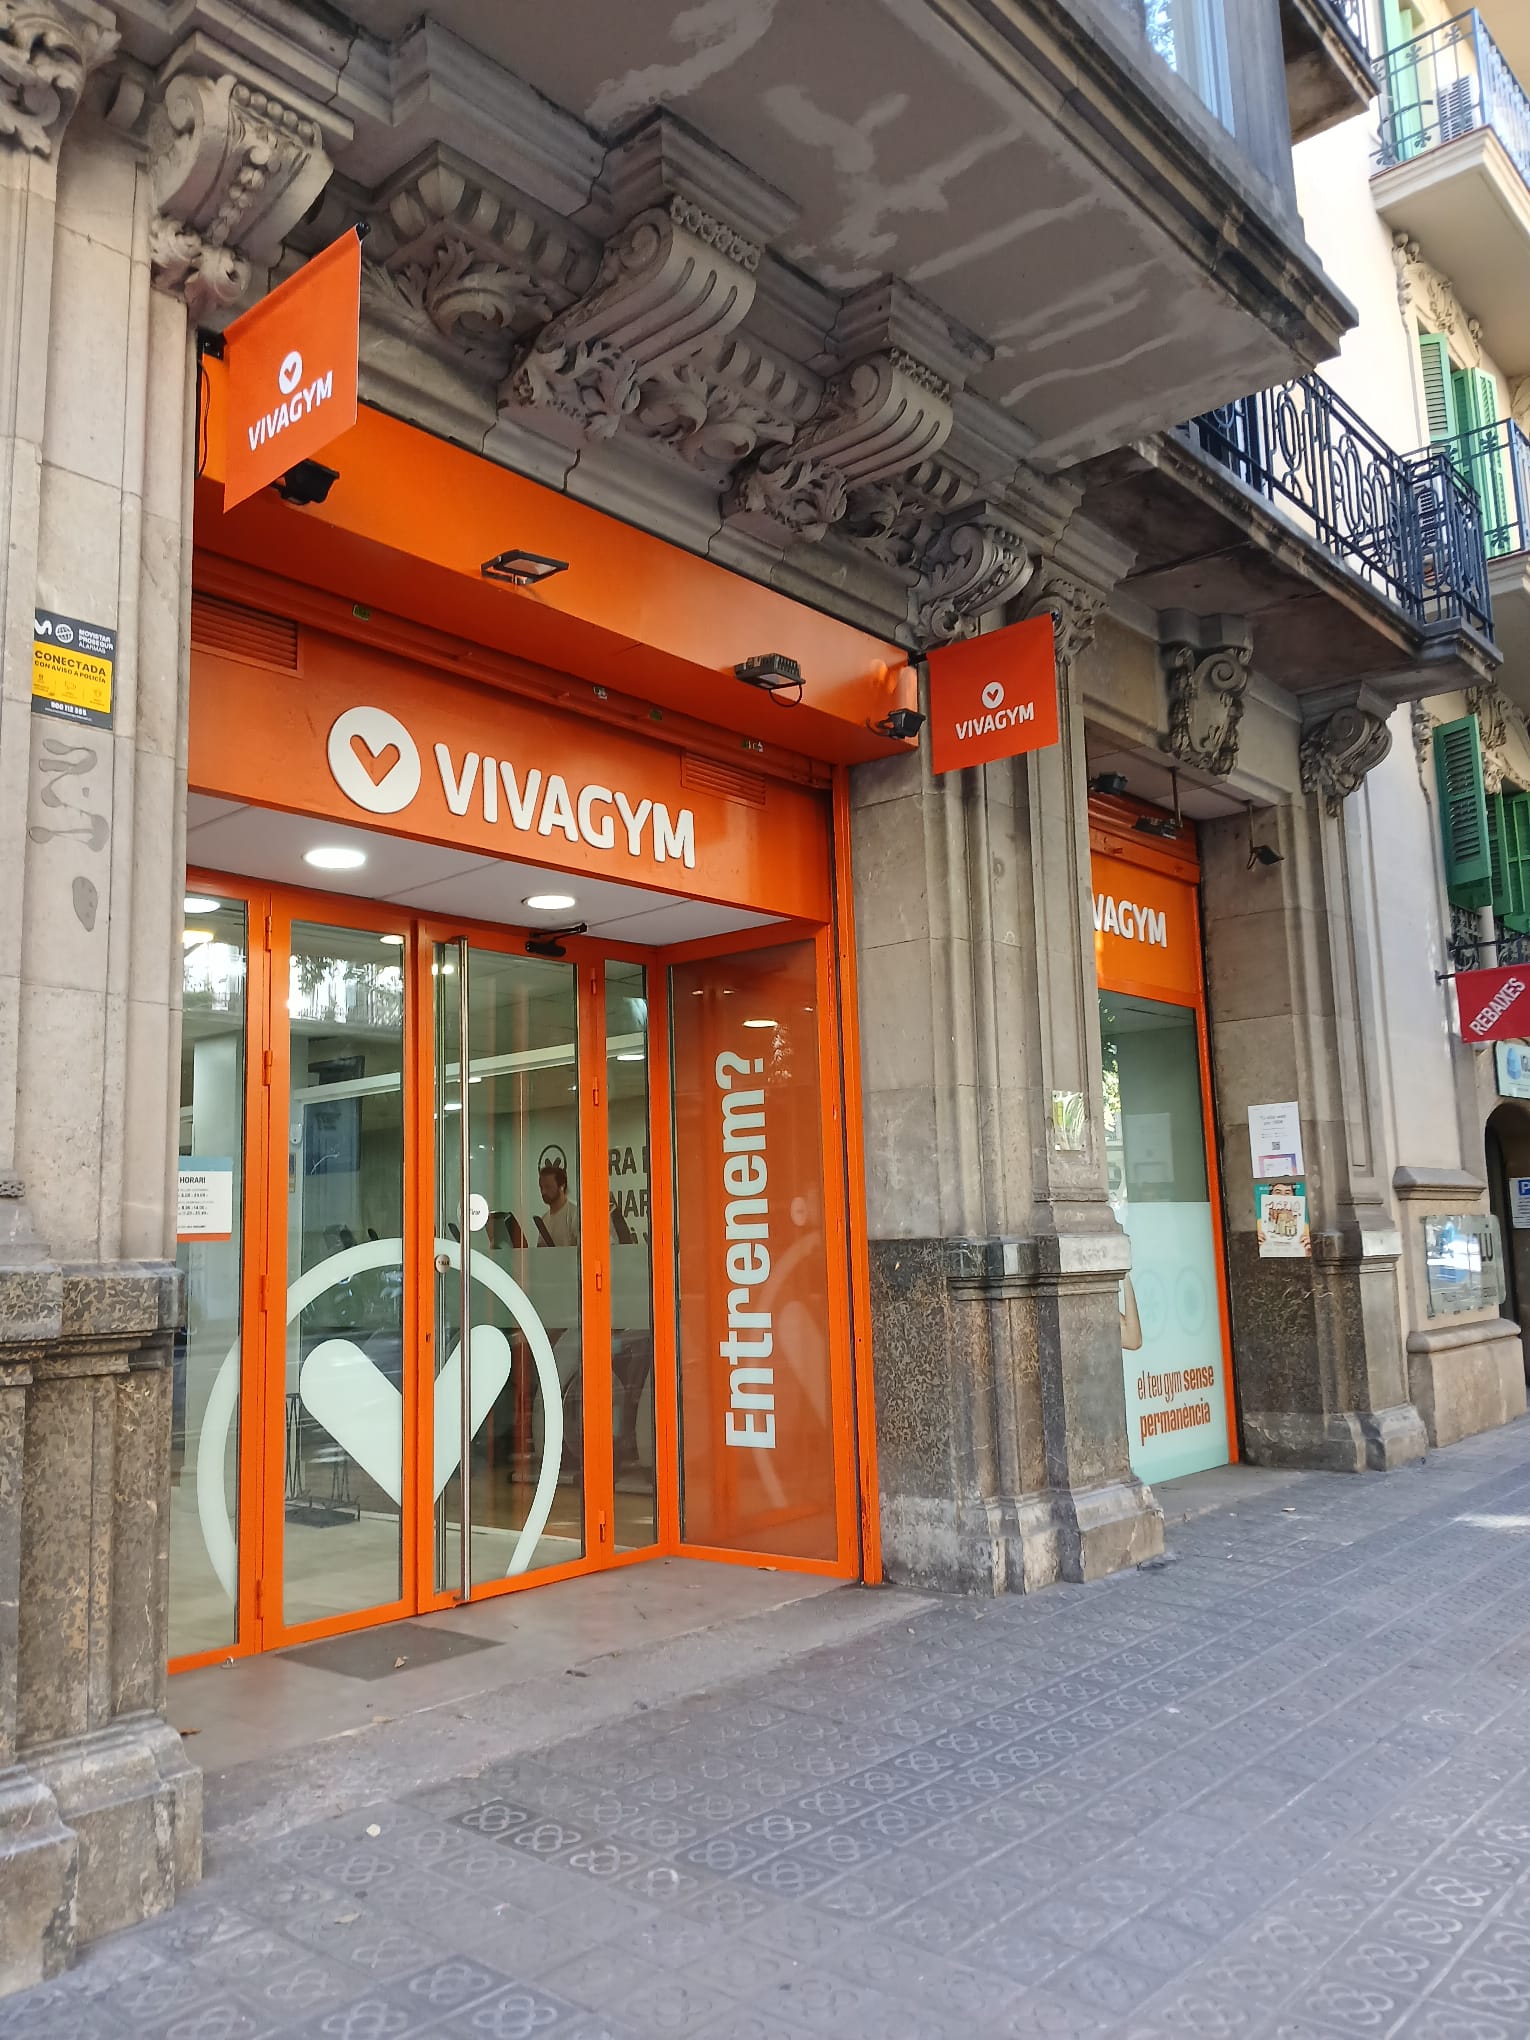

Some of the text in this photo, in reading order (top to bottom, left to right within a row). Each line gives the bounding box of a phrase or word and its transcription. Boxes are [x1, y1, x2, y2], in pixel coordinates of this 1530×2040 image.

[248, 370, 333, 451] VIVAGYM
[35, 650, 106, 677] CONECTADA
[35, 660, 50, 669] CON
[52, 665, 73, 675] AVISO
[956, 701, 1035, 740] VIVAGYM
[434, 742, 696, 869] VIVAGYM
[1469, 977, 1526, 1036] REBAIXES
[179, 1176, 206, 1184] HORARI
[715, 1050, 776, 1449] Entrenem?
[1137, 1365, 1215, 1403] el teu gym sense
[1140, 1397, 1211, 1447] permanència
